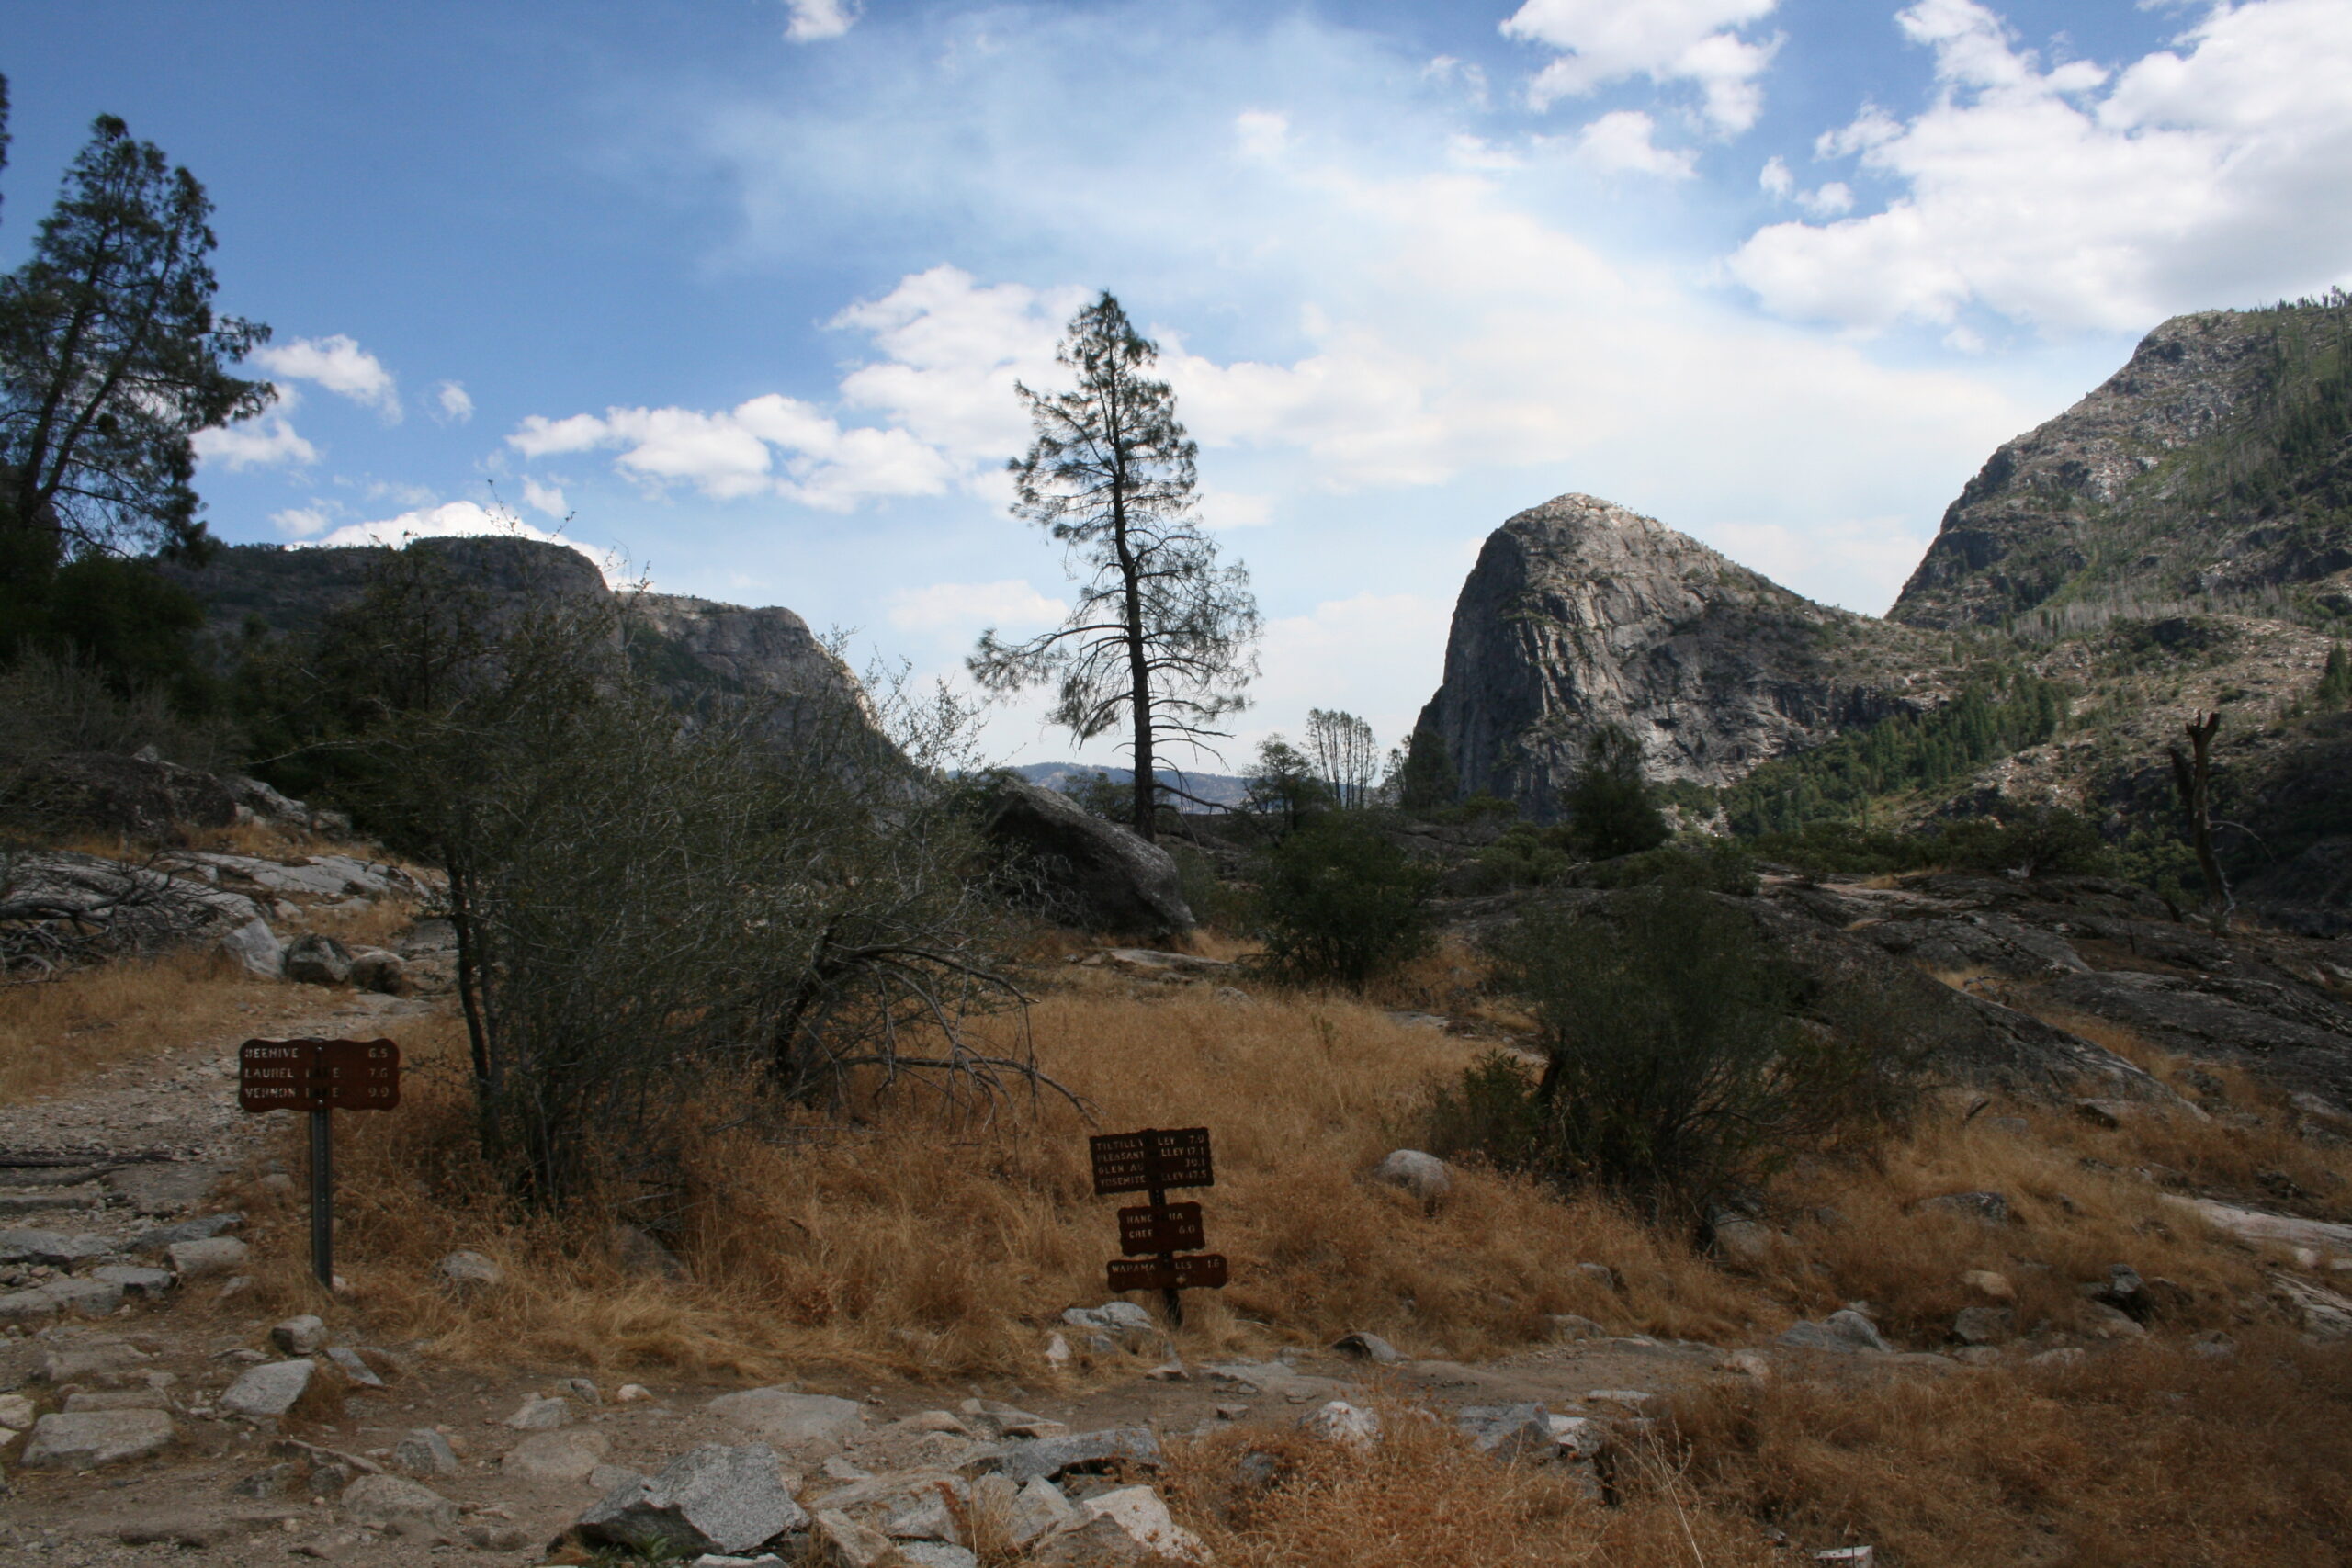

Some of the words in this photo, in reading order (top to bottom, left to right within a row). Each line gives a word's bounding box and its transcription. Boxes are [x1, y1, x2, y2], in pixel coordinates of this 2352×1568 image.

[244, 1047, 299, 1058] BEEHIVE
[368, 1047, 388, 1058] 6.5
[244, 1067, 294, 1078] LAUREL
[244, 1087, 296, 1098] VERNON
[1095, 1139, 1135, 1151] TILTILL
[1096, 1150, 1144, 1163] PLEASANT
[1098, 1164, 1124, 1175] GLEN
[1099, 1175, 1146, 1187] YOSEMITE
[1128, 1228, 1154, 1239] CREE
[1111, 1262, 1156, 1273] WAPAMA
